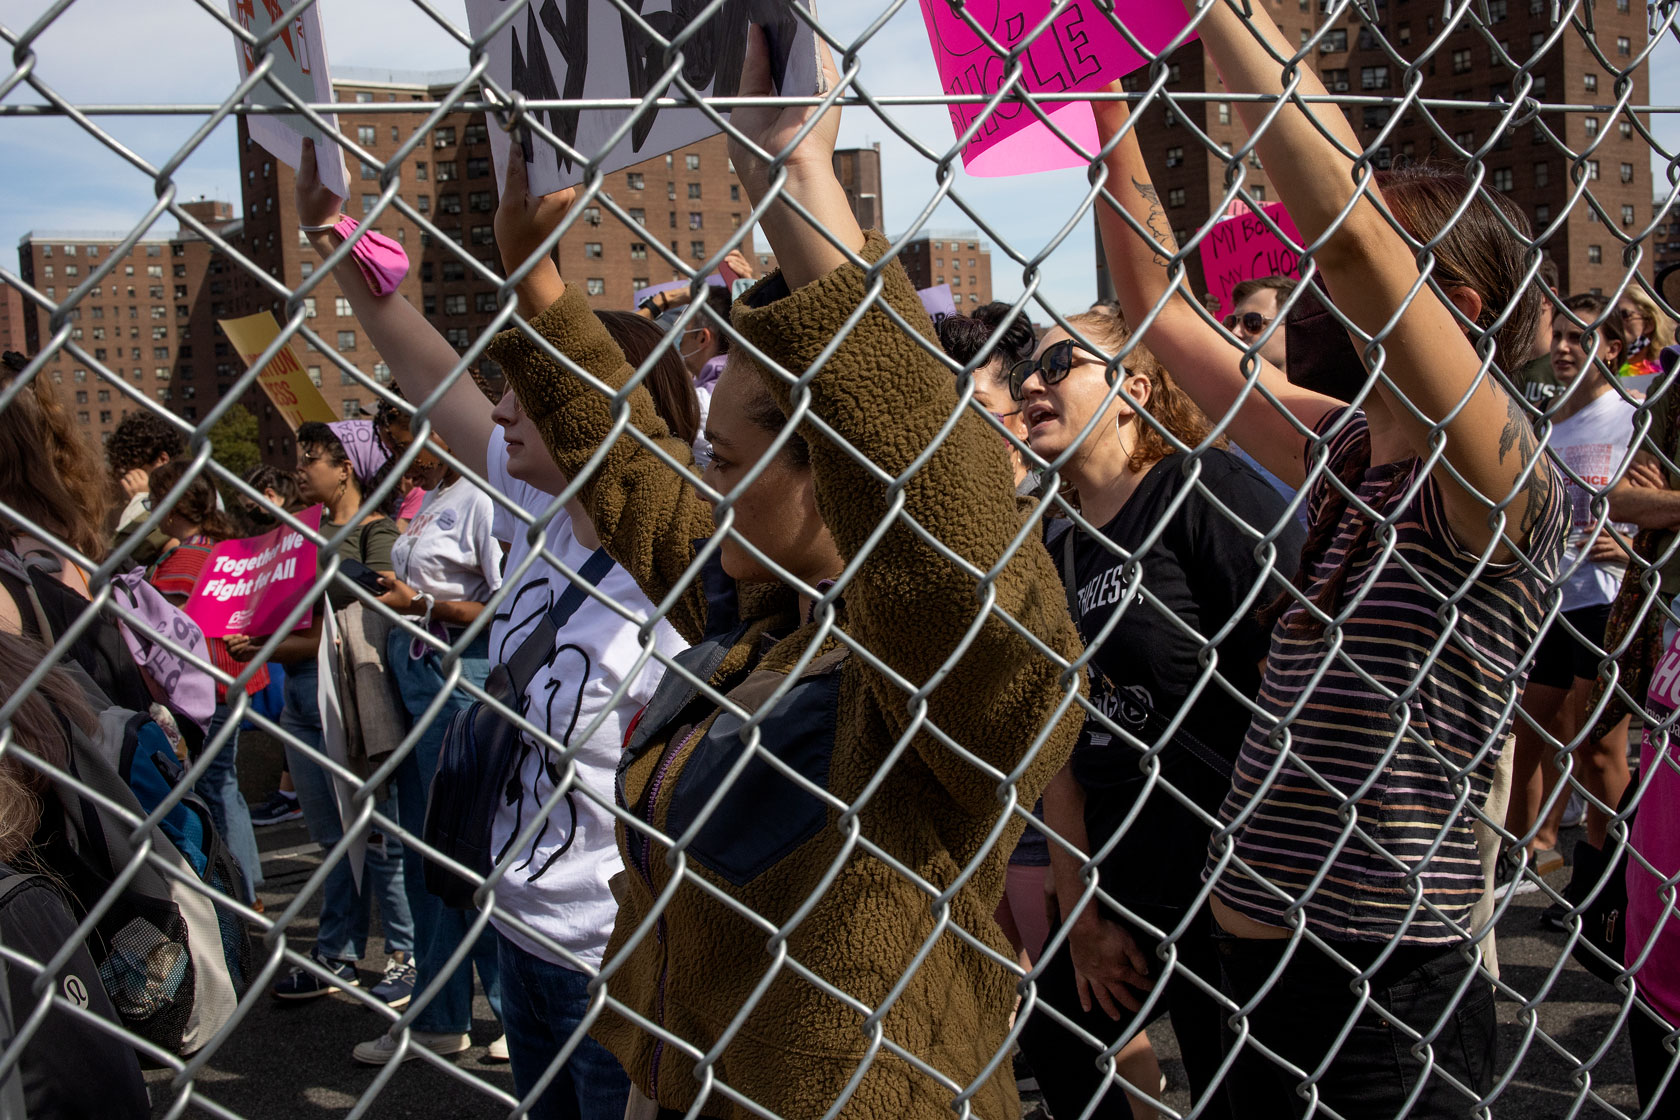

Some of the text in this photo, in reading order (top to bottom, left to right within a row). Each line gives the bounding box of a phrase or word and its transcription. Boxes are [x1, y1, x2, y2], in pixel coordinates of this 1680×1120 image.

[511, 0, 588, 174] MY
[1211, 211, 1279, 260] MY BOY
[212, 531, 305, 578] Together We
[201, 557, 297, 602] Fight for All
